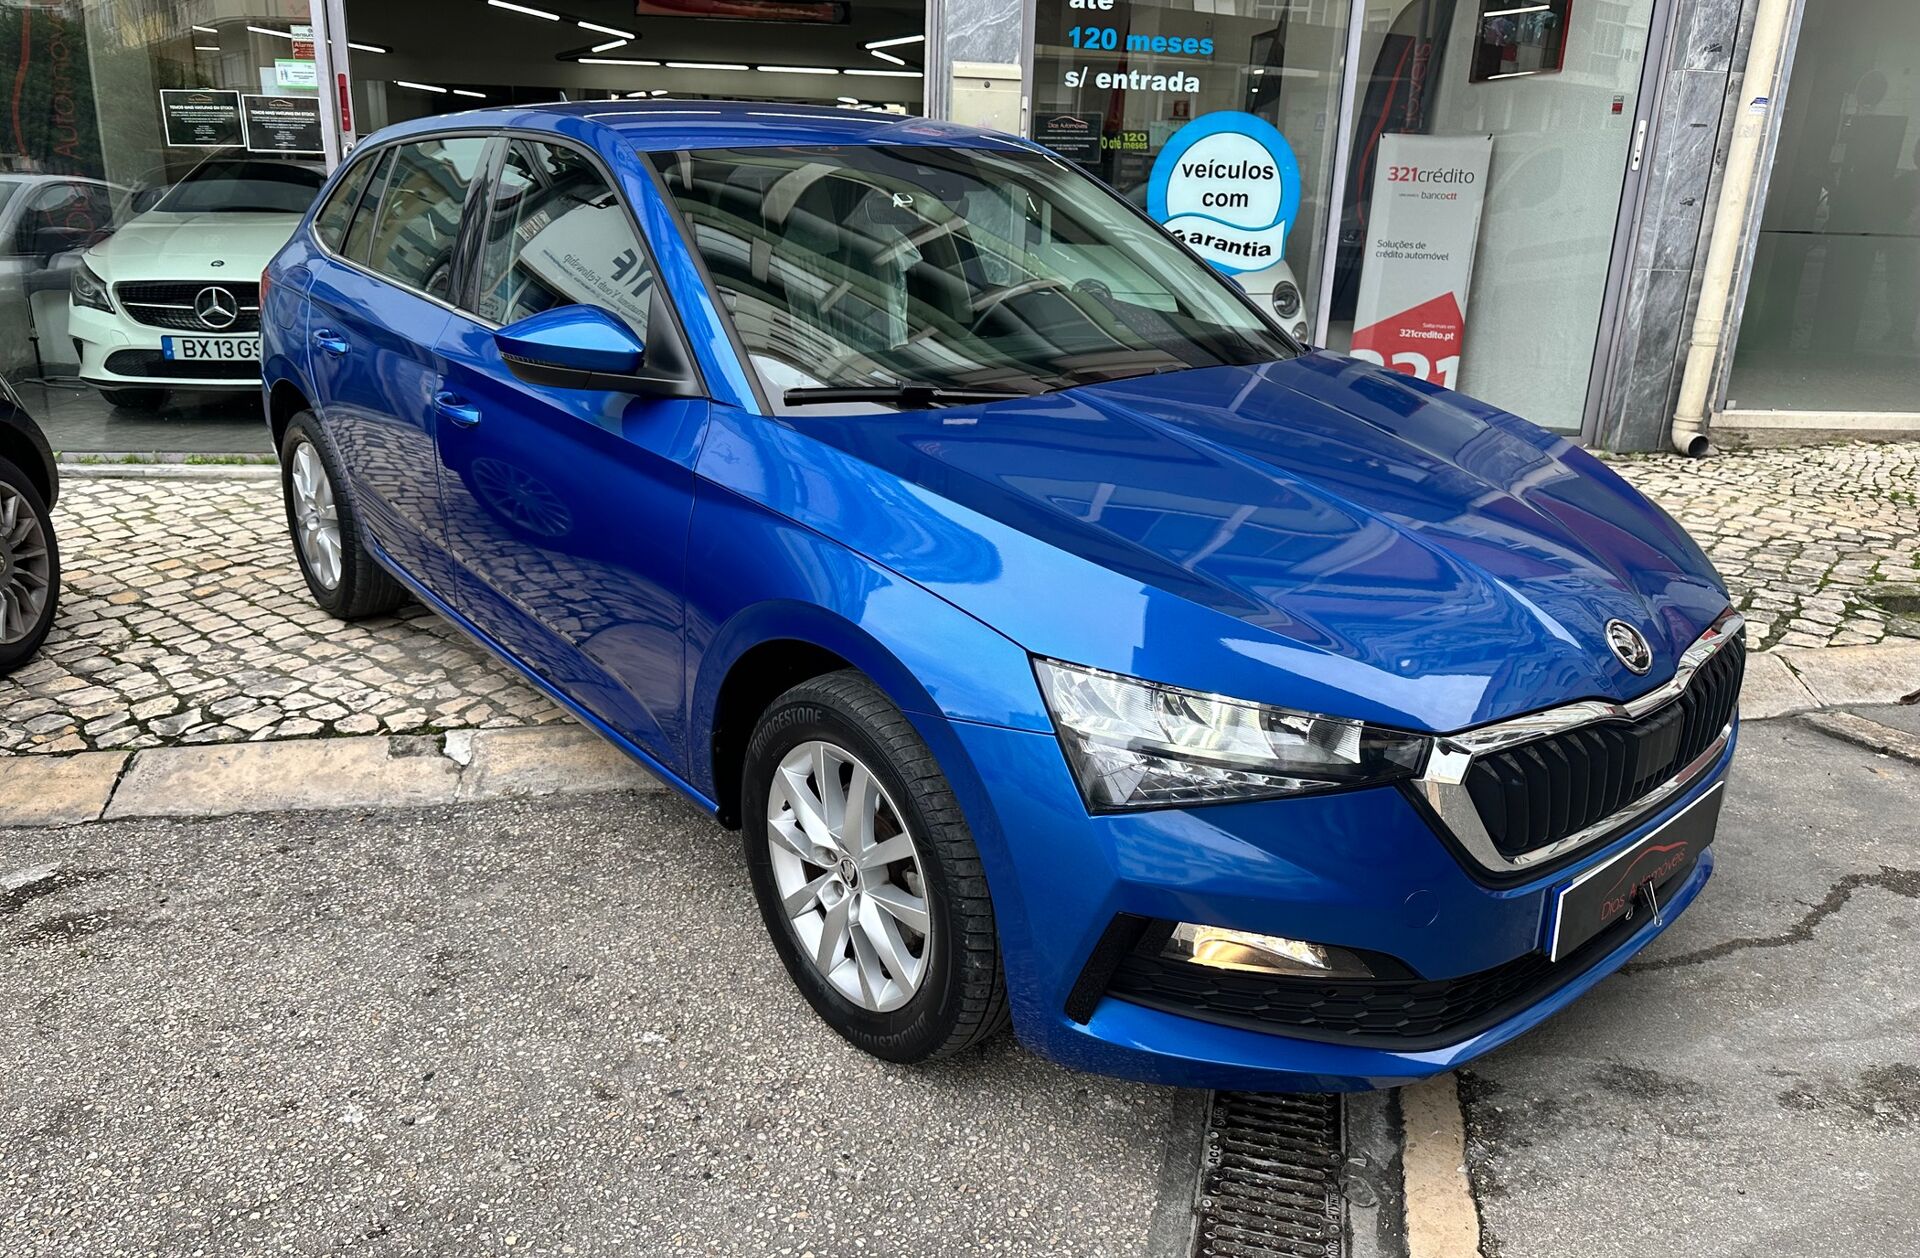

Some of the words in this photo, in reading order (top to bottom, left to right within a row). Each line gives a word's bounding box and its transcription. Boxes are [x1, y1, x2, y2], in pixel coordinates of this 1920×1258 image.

[1068, 26, 1118, 50] 120
[1126, 33, 1214, 55] meses
[1064, 66, 1088, 88] s/
[1095, 69, 1200, 93] entrada
[1123, 133, 1147, 142] 120
[1123, 141, 1148, 150] meses
[1182, 159, 1274, 180] veículos
[1387, 166, 1475, 184] 321crédito
[1202, 192, 1249, 207] com
[1420, 191, 1457, 200] bancoctt
[1376, 239, 1414, 250] Soluções
[1415, 241, 1427, 250] de
[1375, 250, 1404, 259] crédito
[1404, 251, 1449, 261] automóvel
[1399, 328, 1455, 341] 321credito.pt
